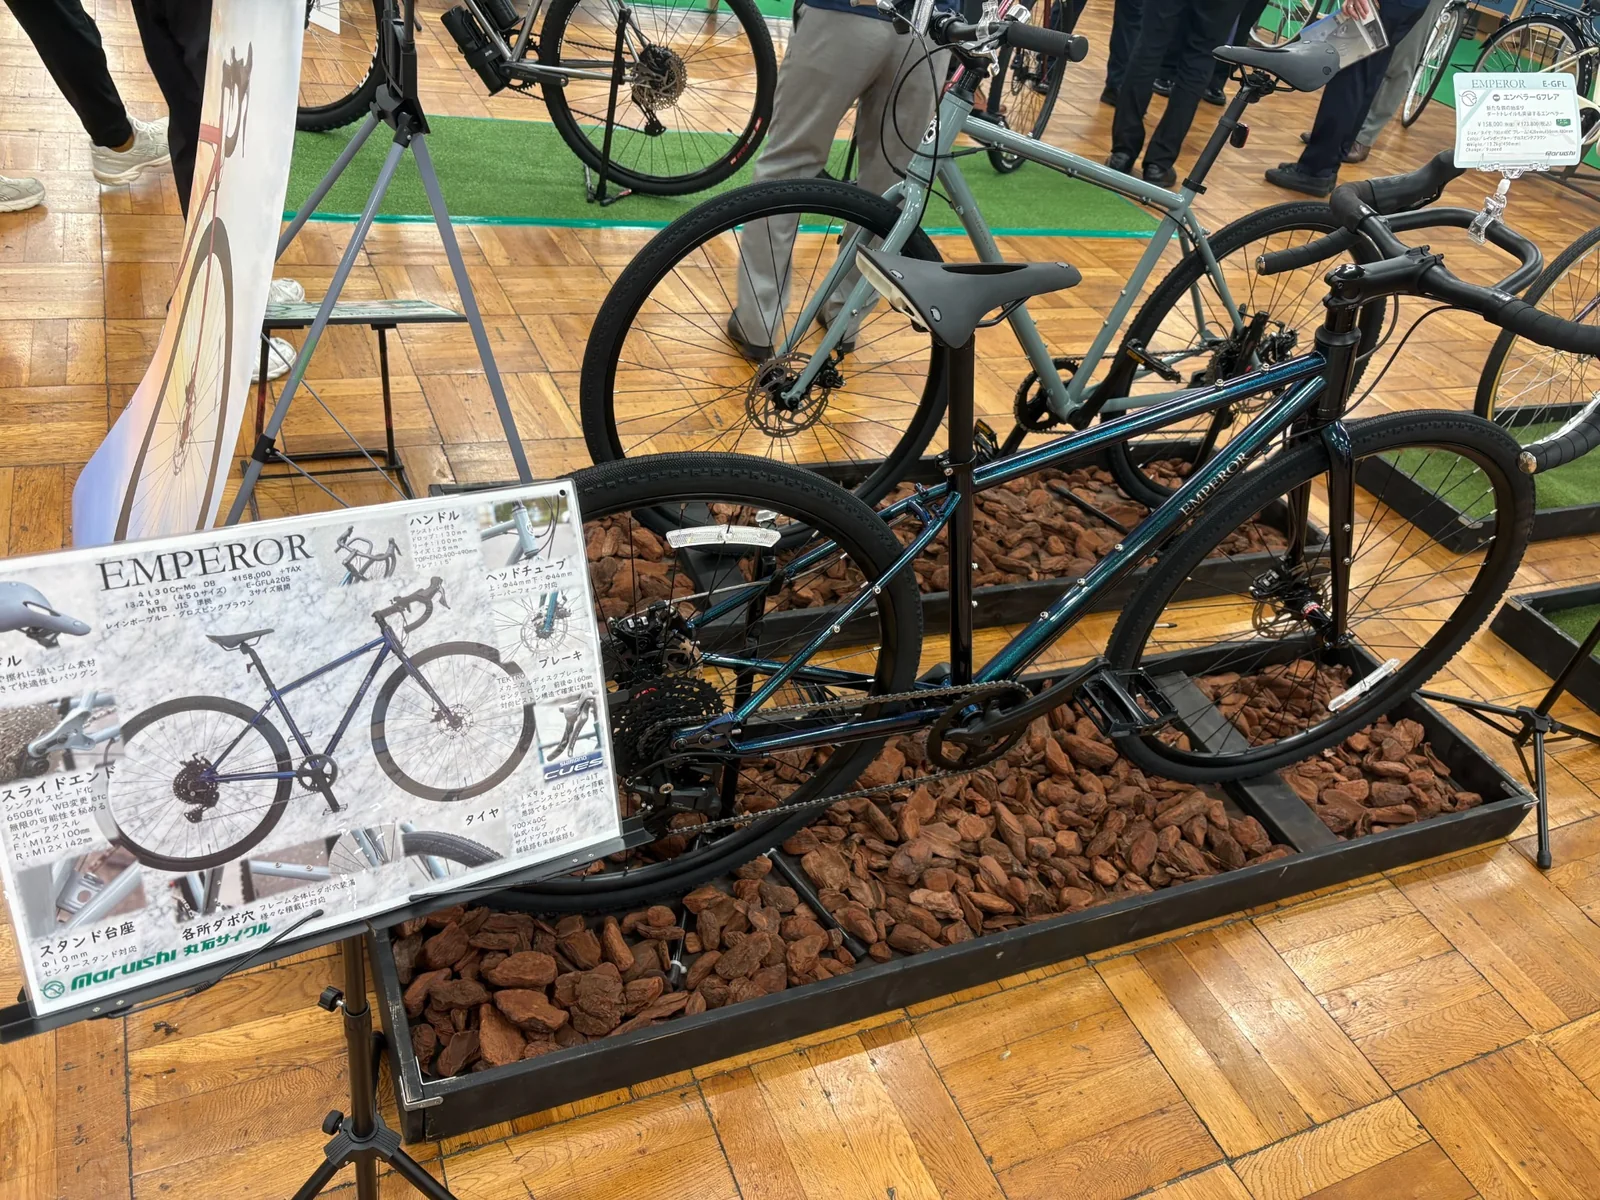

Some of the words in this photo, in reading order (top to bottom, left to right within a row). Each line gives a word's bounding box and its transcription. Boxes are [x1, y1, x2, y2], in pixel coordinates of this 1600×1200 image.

[1471, 79, 1526, 89] EMPEROR
[1542, 80, 1567, 88] E-GFL
[1179, 452, 1249, 516] EMPEROR
[409, 510, 460, 527] ハンドル
[95, 533, 314, 592] EMPEROR
[486, 559, 567, 582] ヘッドチューブ
[232, 571, 272, 582] ¥158,000
[489, 581, 558, 600] テーパーフォーク対応
[147, 605, 168, 615] MTB
[175, 601, 189, 610] JIS
[0, 655, 22, 668] ル
[539, 650, 583, 669] ブレーキ
[497, 673, 526, 685] TEKTRO
[499, 668, 585, 693] メカニカルディスクブレーキ
[544, 757, 604, 780] CUES
[2, 765, 116, 803] スライドエンド
[5, 786, 94, 813] シングルスピード化
[9, 802, 106, 833] 無限の可能性を秘める
[465, 807, 500, 826] タイヤ
[12, 819, 80, 842] スルーアクスル
[515, 824, 568, 846] サイドブロックで
[259, 896, 326, 922] 様々な積載に対応
[182, 911, 256, 941] 各所ダボ穴
[40, 921, 137, 958] スタンド台座
[183, 922, 271, 957] 丸石サイクル
[43, 945, 138, 977] センタースタンド対応
